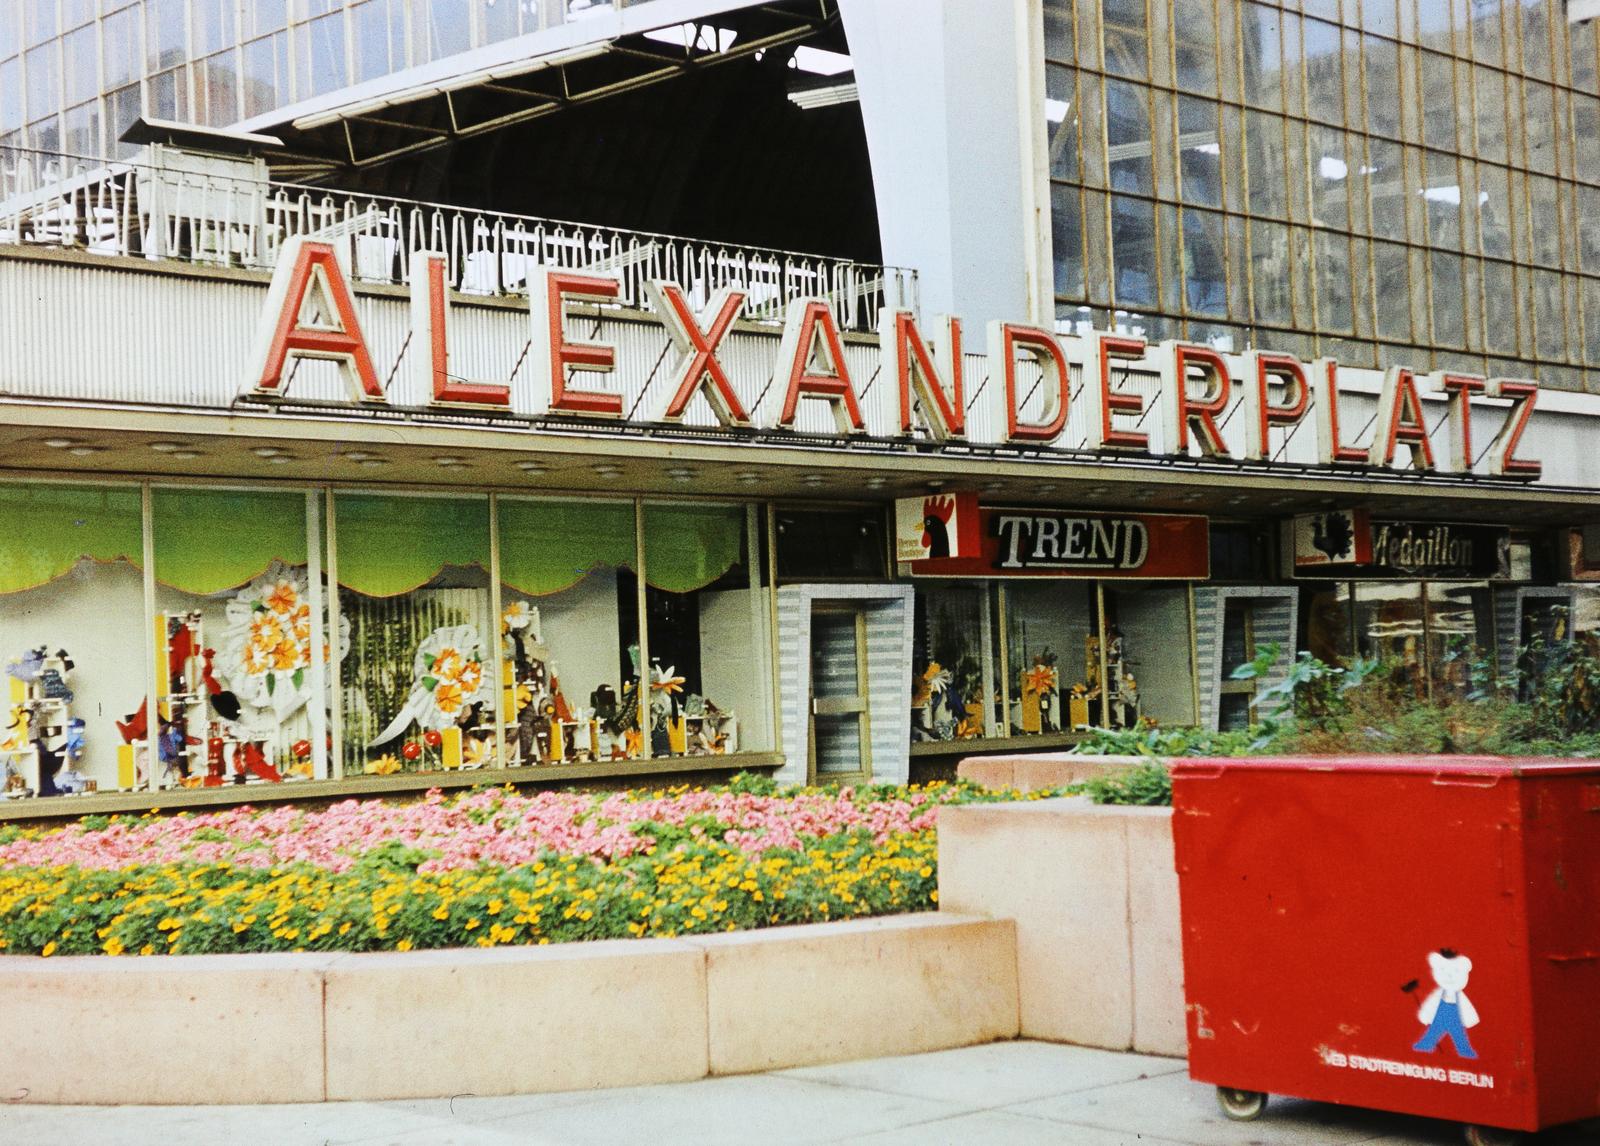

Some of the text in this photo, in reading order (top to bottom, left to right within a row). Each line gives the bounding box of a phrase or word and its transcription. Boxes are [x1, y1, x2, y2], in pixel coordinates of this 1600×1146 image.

[240, 235, 1541, 480] ALEXANDERPLATZ
[998, 515, 1149, 569] TREND
[1374, 525, 1473, 566] Medaillon
[1323, 1050, 1494, 1089] VEB STADTREINIGUNG BERLIN
